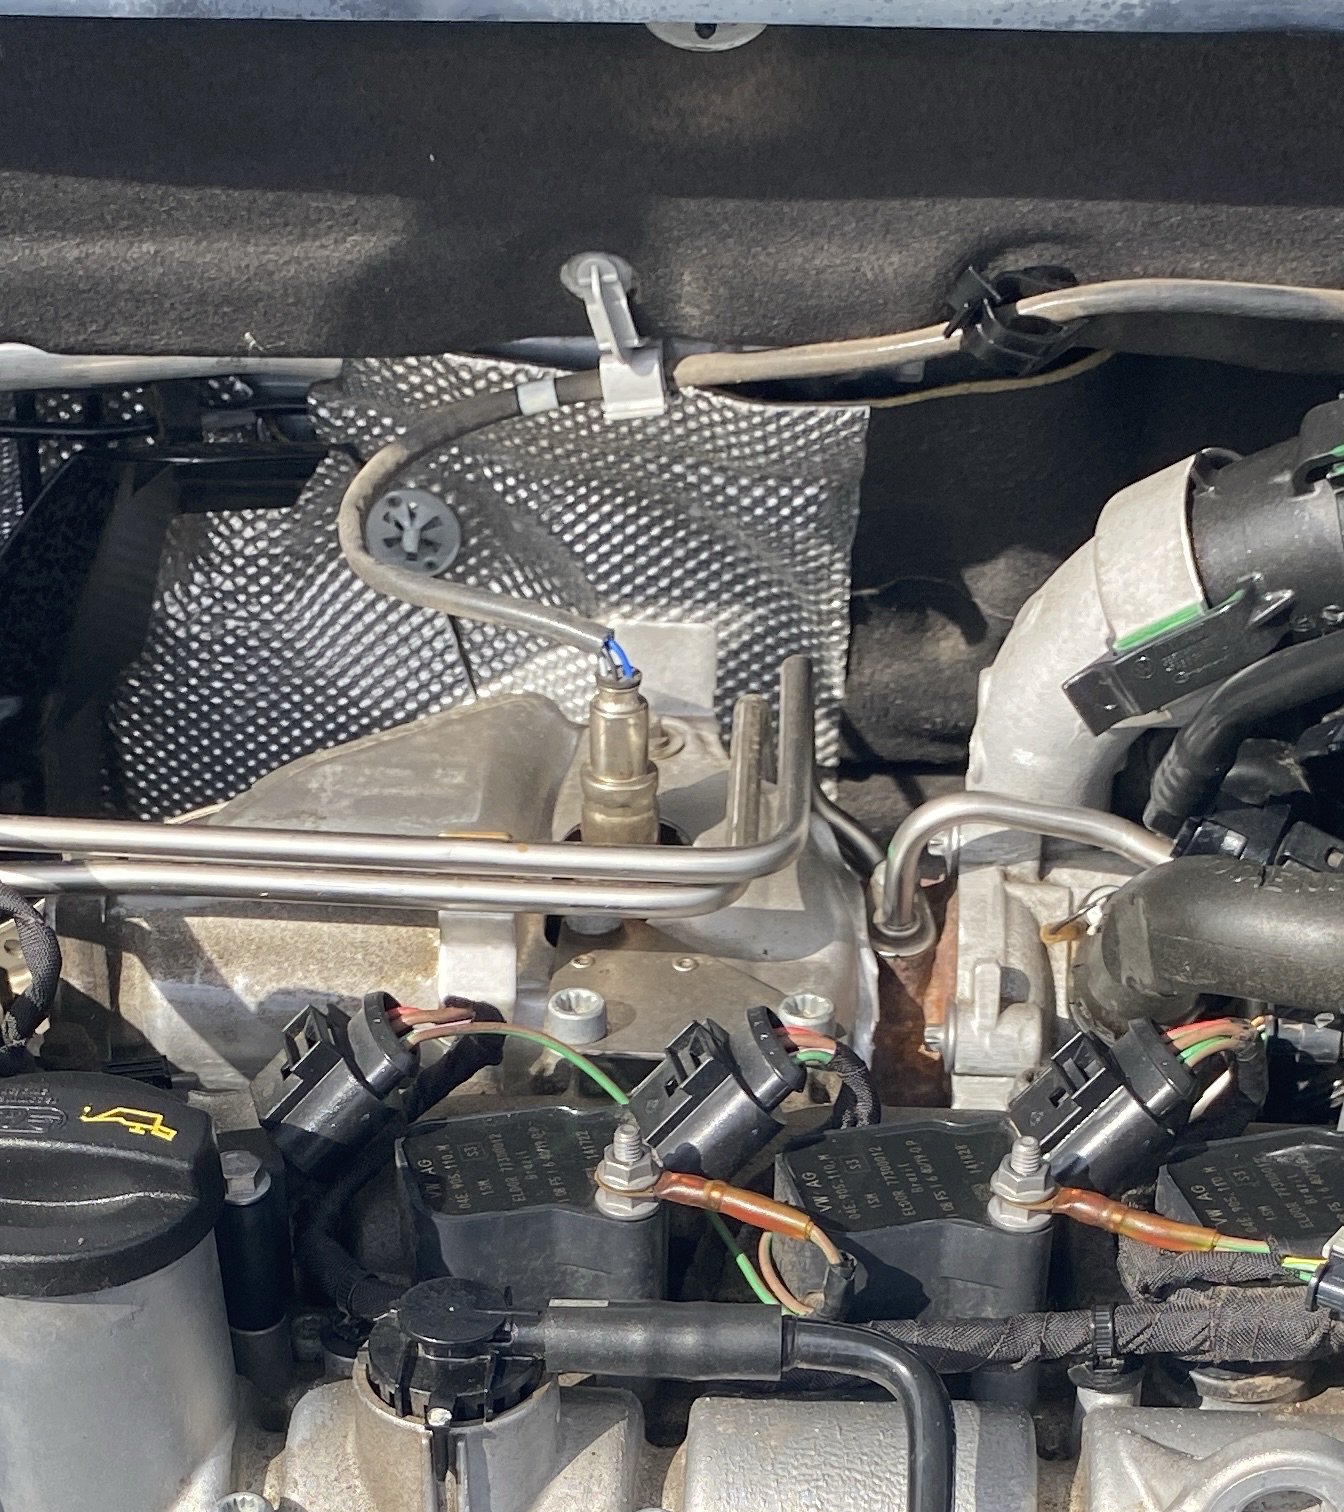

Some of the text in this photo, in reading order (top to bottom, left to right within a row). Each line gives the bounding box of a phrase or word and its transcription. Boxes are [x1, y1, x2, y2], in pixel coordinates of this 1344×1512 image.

[416, 1158, 436, 1174] AG
[845, 1156, 862, 1171] S3
[868, 1145, 900, 1185] 77300012
[800, 1170, 832, 1212] VW AG
[1189, 1183, 1228, 1224] VW AG
